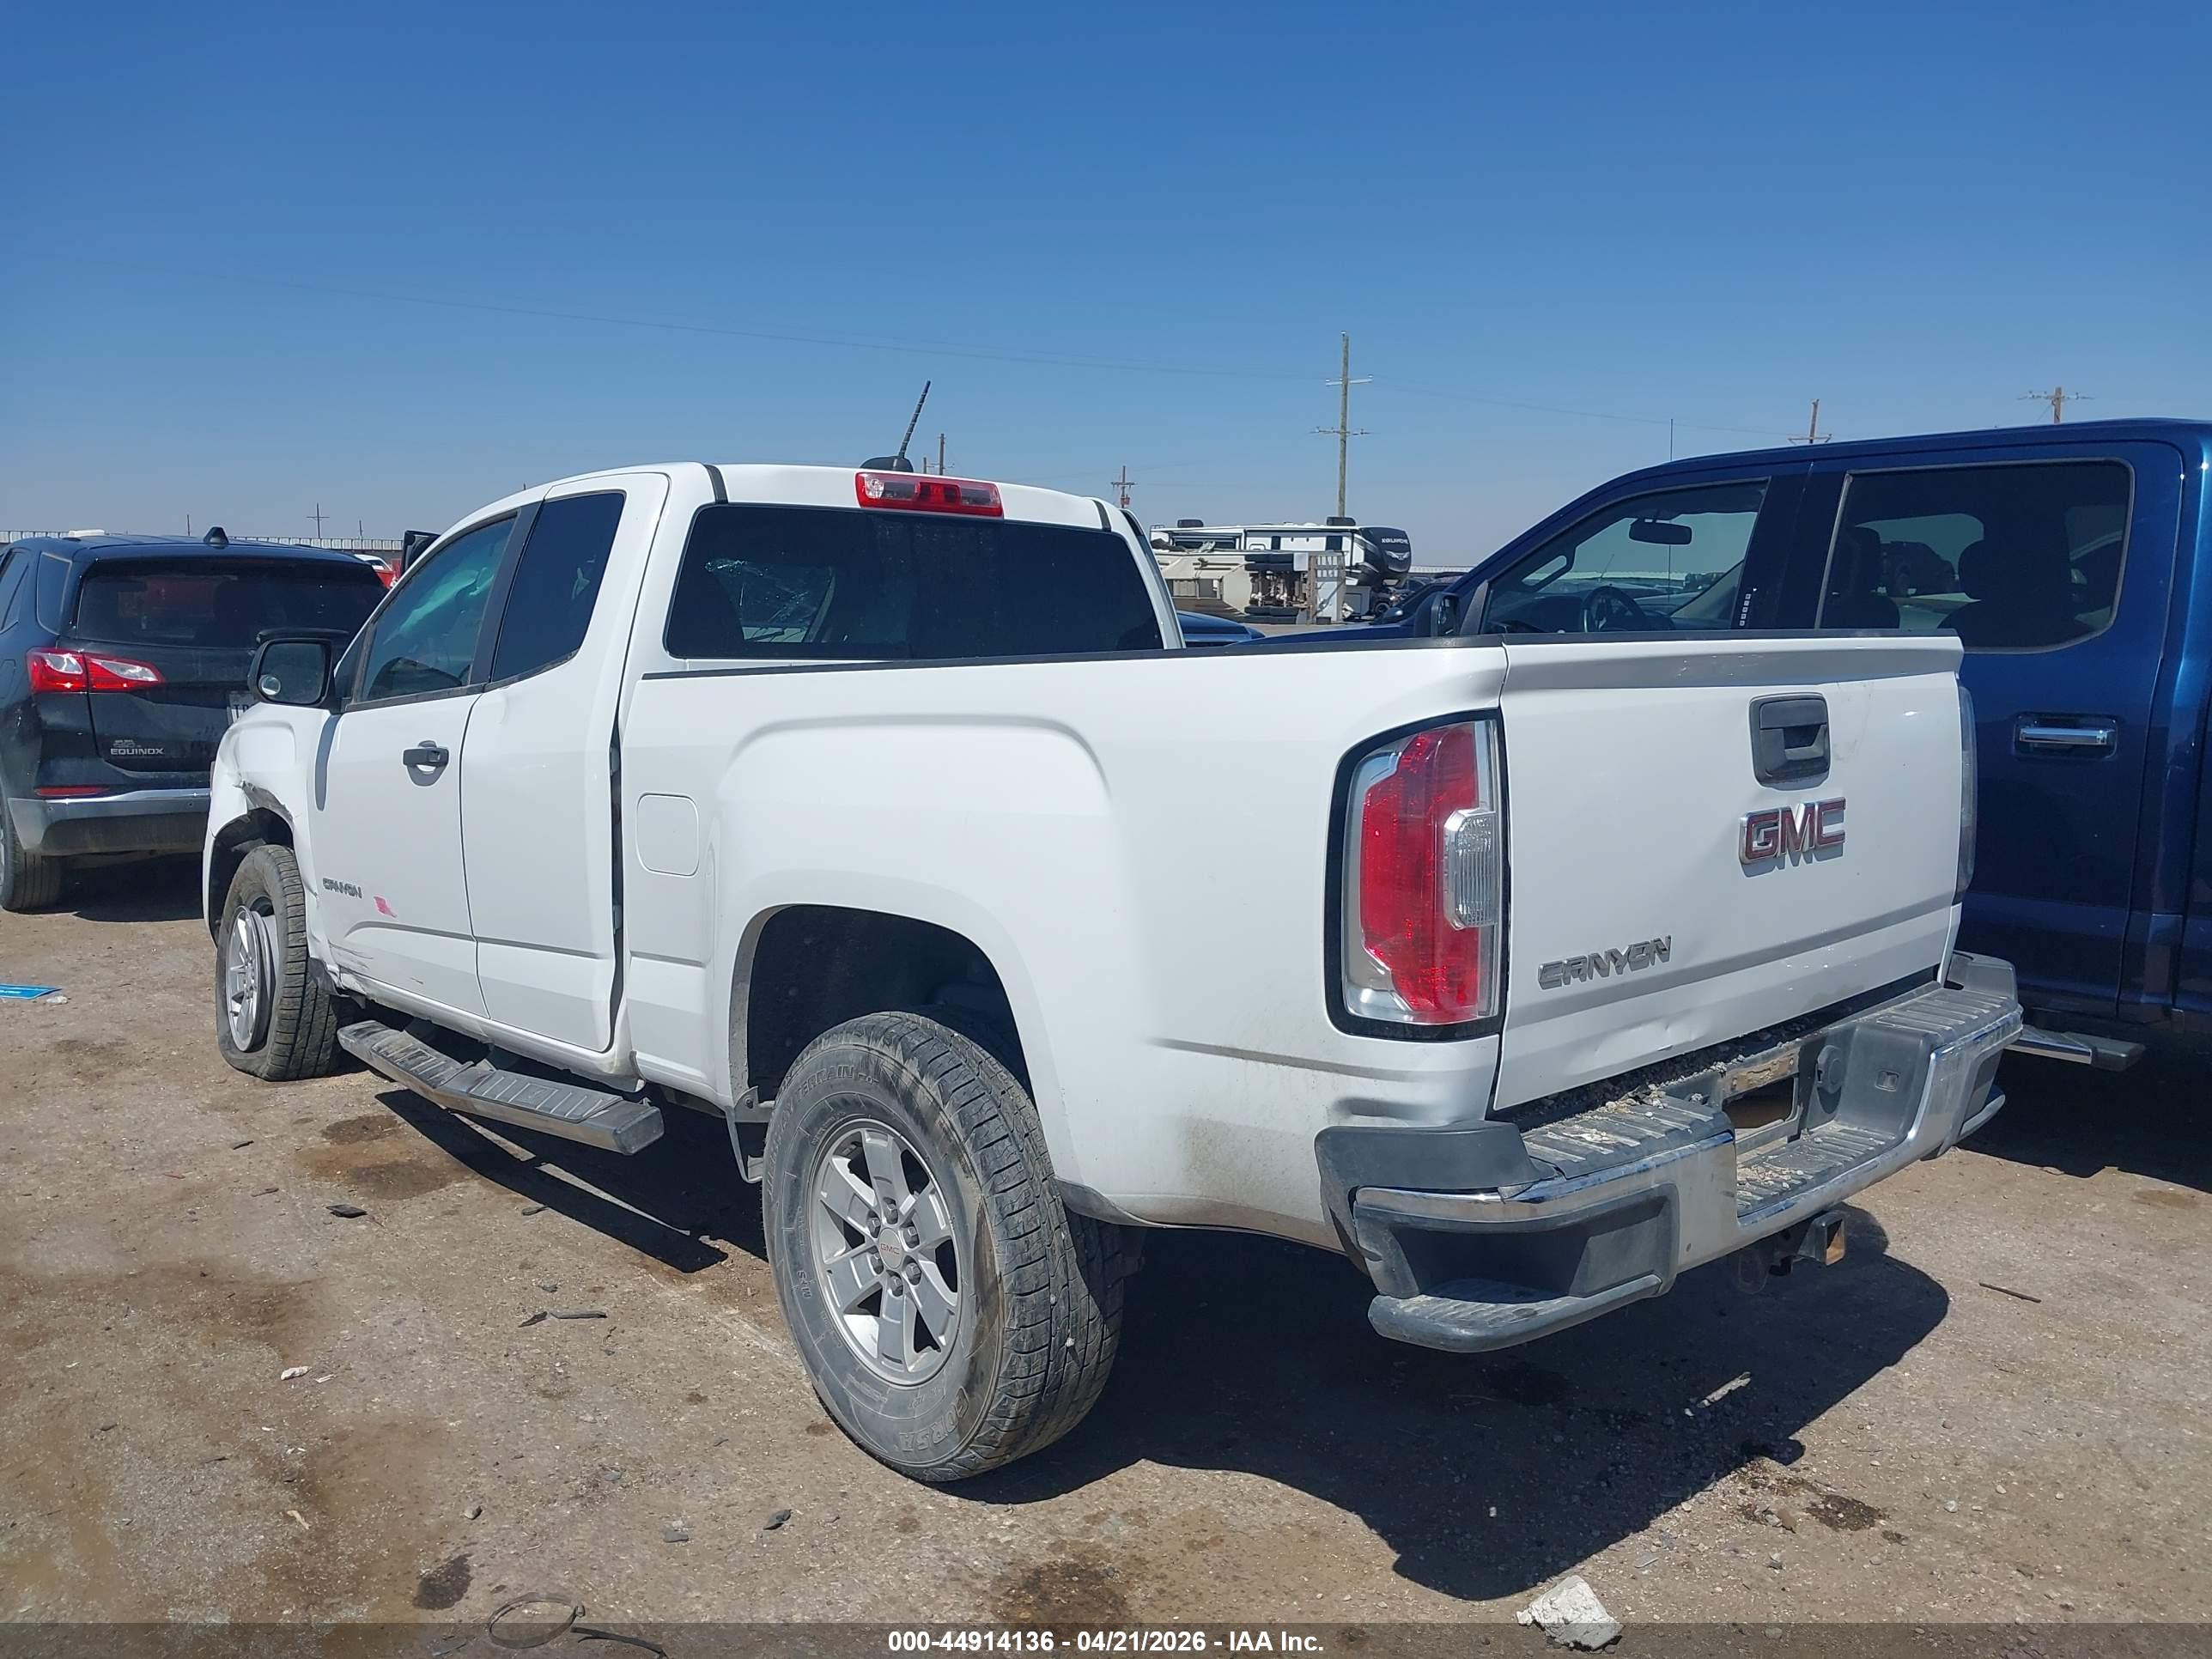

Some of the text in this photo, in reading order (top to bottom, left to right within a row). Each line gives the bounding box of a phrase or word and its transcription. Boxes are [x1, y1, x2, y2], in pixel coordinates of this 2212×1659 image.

[1738, 797, 1846, 866] GMC
[322, 878, 362, 899] CANYON
[1537, 935, 1672, 988] CANYON
[880, 1243, 900, 1255] GMC
[898, 1385, 969, 1453] CORSA
